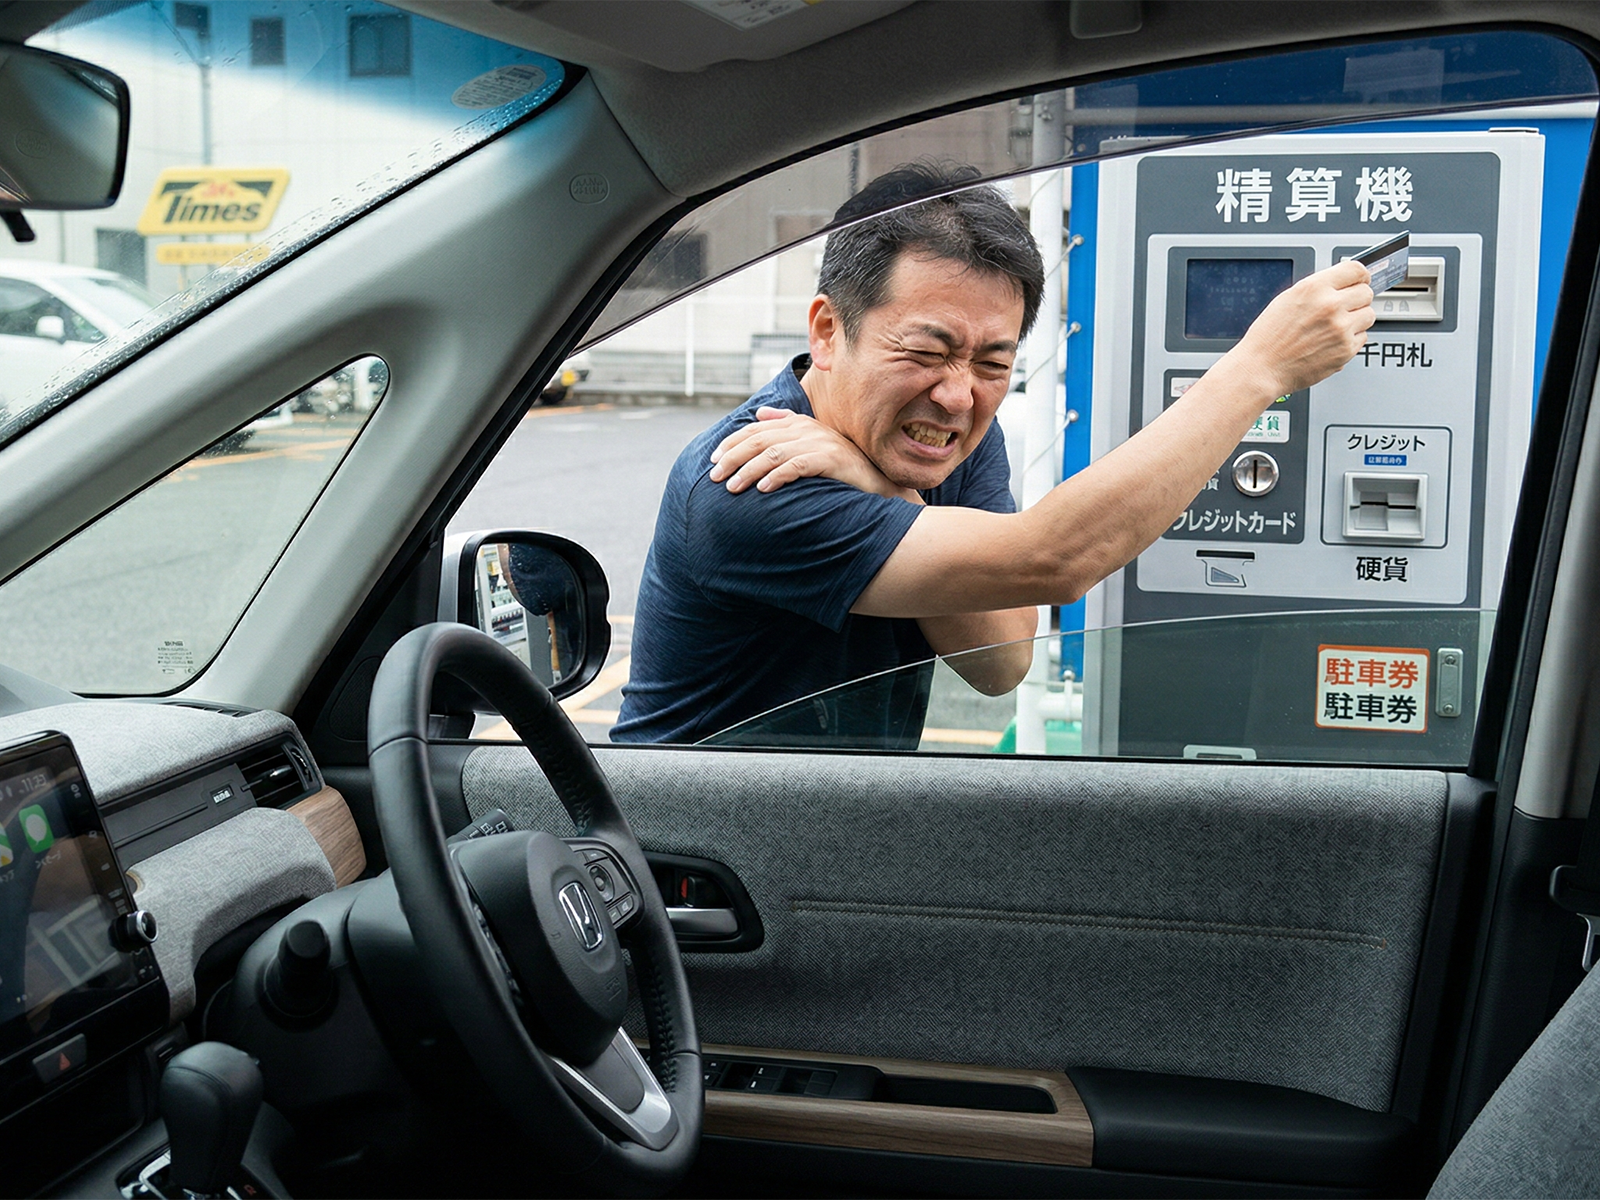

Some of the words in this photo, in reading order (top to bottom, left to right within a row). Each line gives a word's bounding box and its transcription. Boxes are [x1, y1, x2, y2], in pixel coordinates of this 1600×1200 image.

[163, 193, 262, 224] Times
[1215, 166, 1414, 223] 精算機
[1357, 342, 1433, 368] 千円札
[1347, 433, 1426, 452] クレジット
[1356, 556, 1409, 582] 硬貨
[1324, 657, 1419, 689] 駐車券
[1323, 692, 1417, 724] 駐車券
